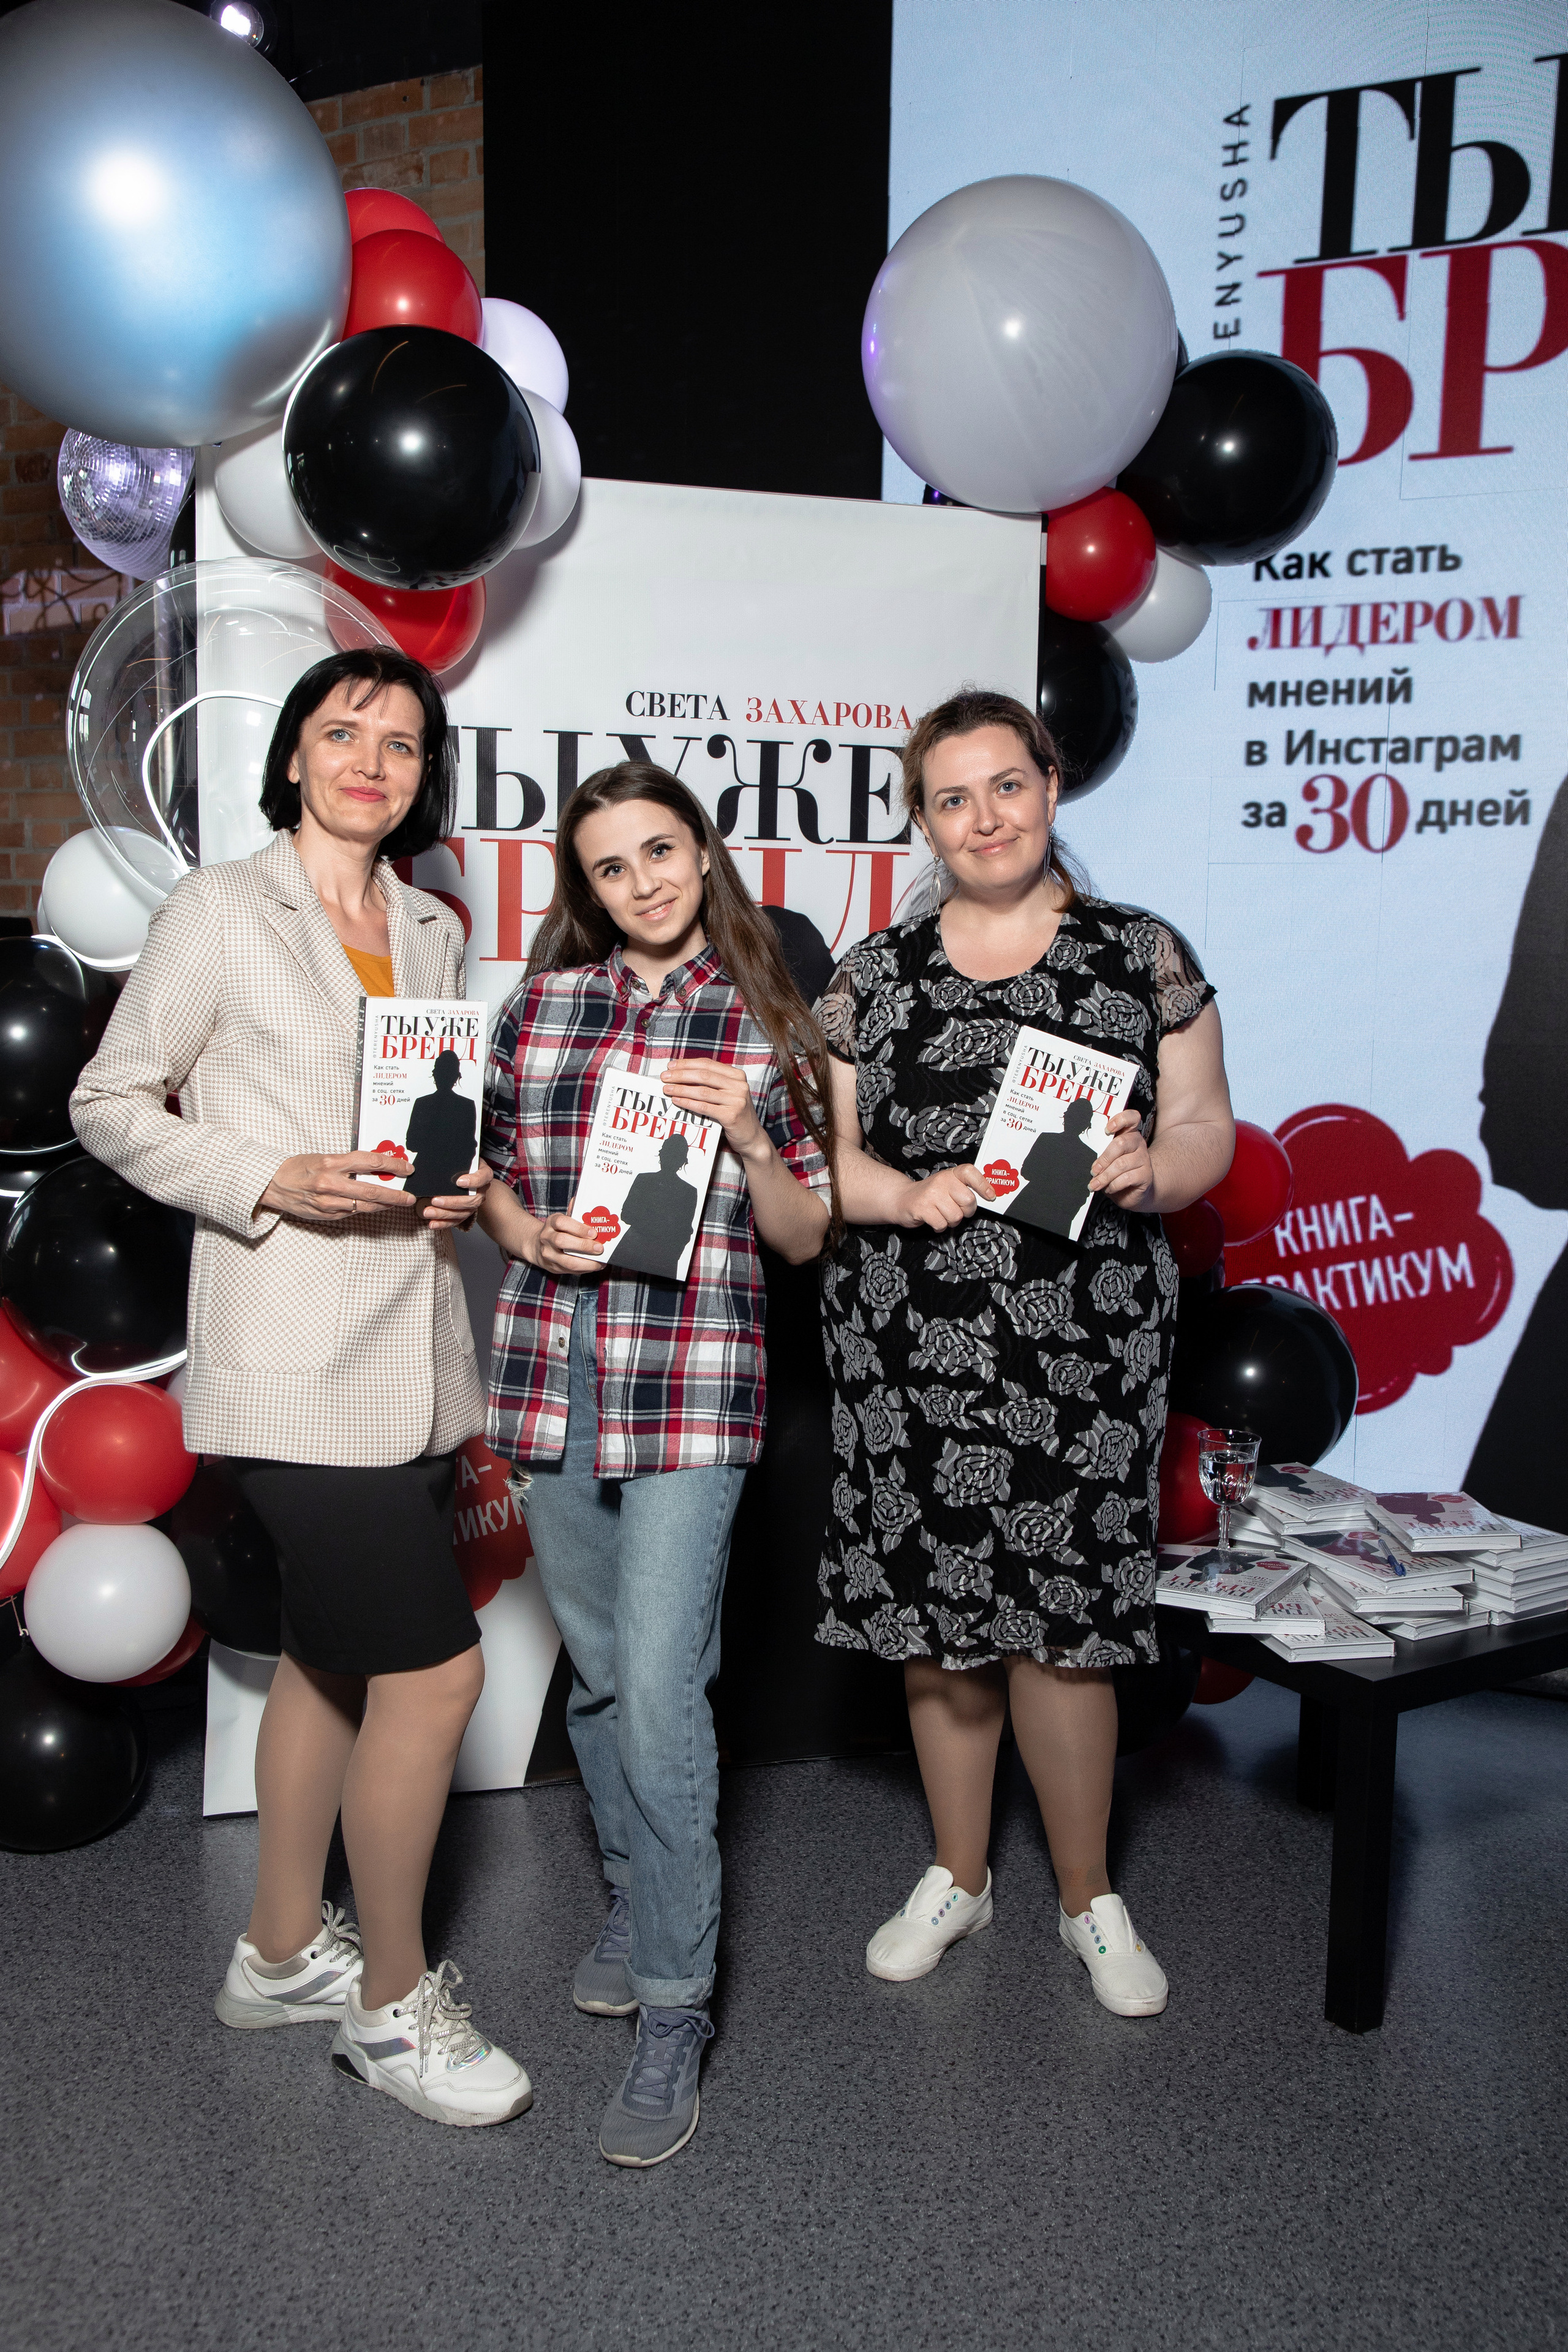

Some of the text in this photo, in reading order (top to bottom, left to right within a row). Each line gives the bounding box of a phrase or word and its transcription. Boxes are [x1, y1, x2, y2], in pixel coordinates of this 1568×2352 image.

[1253, 544, 1463, 582] Как стать
[1246, 594, 1526, 657] ЛИДЕРОМ
[1247, 667, 1413, 709] мнений
[625, 690, 912, 730] СВЕТА ЗАХАРОВА
[1245, 729, 1523, 772] в Инстаграм
[1242, 772, 1531, 854] за 30 дней
[380, 1015, 479, 1037] ТЫ УЖЕ
[379, 1035, 478, 1066] БРЕНД
[1073, 1055, 1125, 1077] СВЕТА ЗАХАРОВА
[1027, 1047, 1123, 1096] ТЫ УЖЕ
[379, 1094, 396, 1106] 30
[616, 1087, 657, 1114] ТЫ
[1007, 1096, 1040, 1111] ЛИДЕРОМ
[1017, 1065, 1118, 1121] БРЕНД
[1005, 1104, 1025, 1114] мнений
[1006, 1117, 1022, 1131] 30
[1019, 1115, 1033, 1124] сетях
[600, 1140, 633, 1152] ЛИДЕРОМ
[609, 1106, 711, 1156] БРЕНД
[601, 1162, 618, 1175] 30
[1274, 1193, 1414, 1258] КНИГА-
